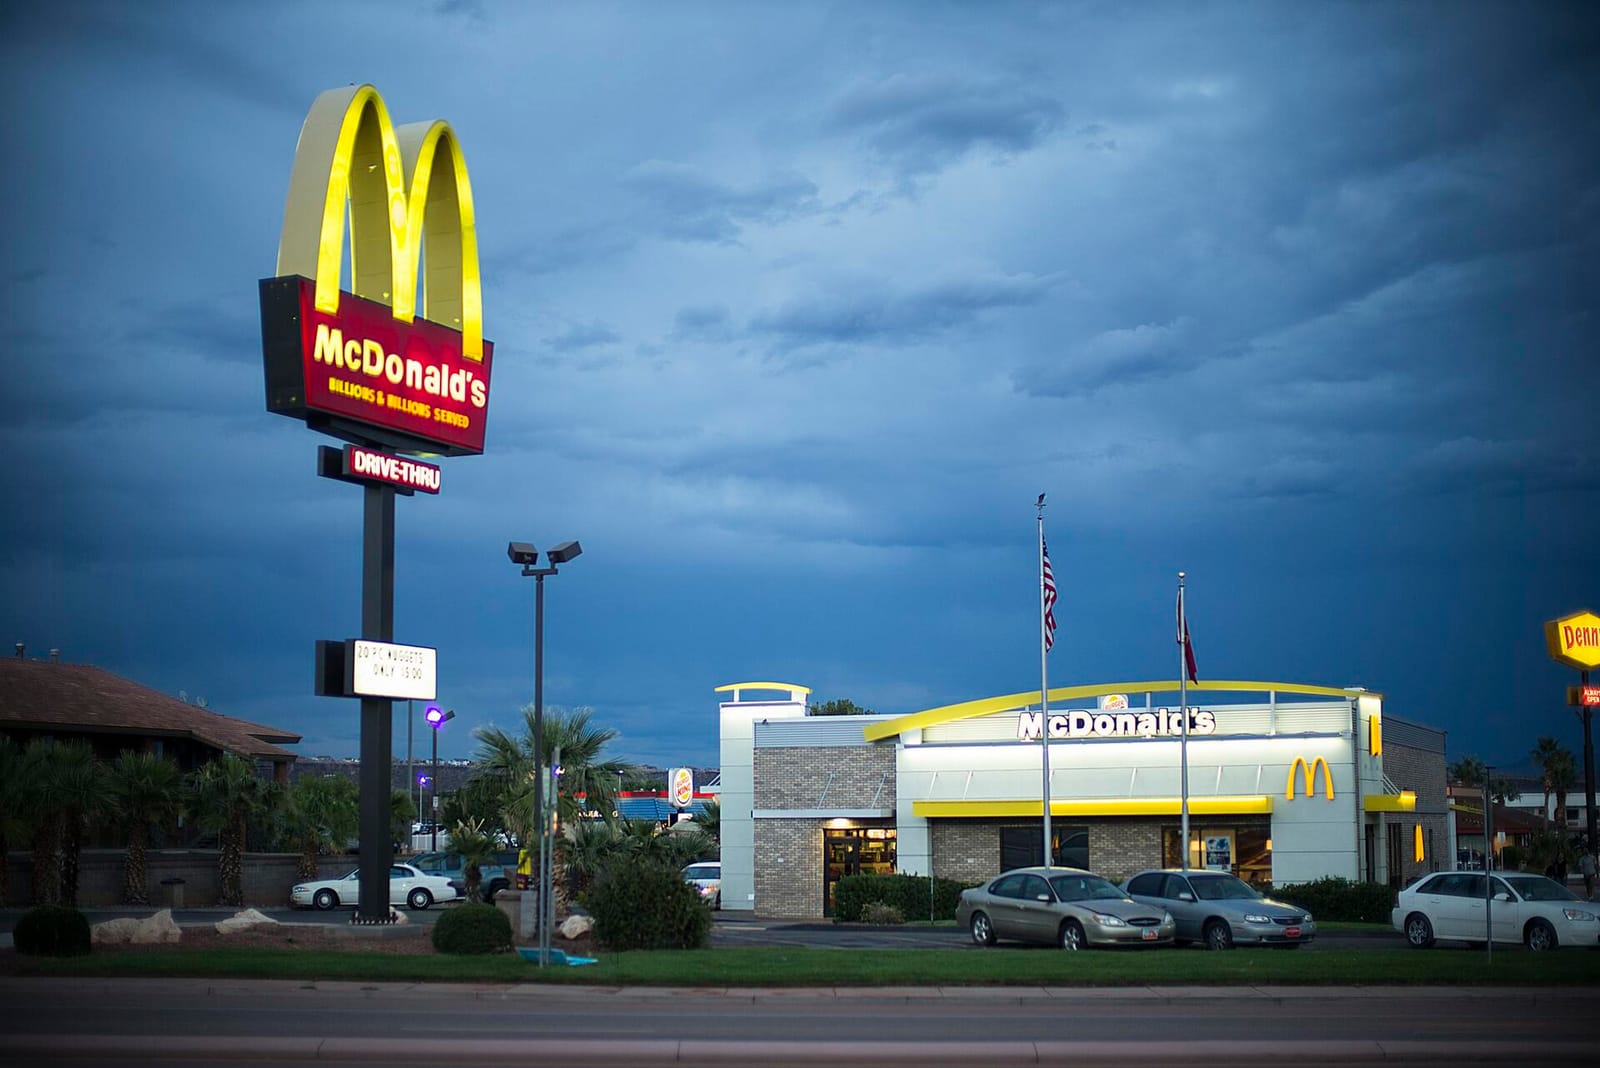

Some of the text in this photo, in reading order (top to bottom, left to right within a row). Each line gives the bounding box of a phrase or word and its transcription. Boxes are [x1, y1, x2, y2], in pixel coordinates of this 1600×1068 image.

[313, 323, 487, 408] McDonald's
[328, 377, 469, 429] BILLIONS & BILLIONS SERVED
[354, 450, 440, 490] DRIVE-THRU
[358, 645, 369, 658] 20
[386, 648, 423, 664] NUGGETS
[1563, 625, 1600, 649] Denn
[1018, 707, 1216, 738] McDonald's
